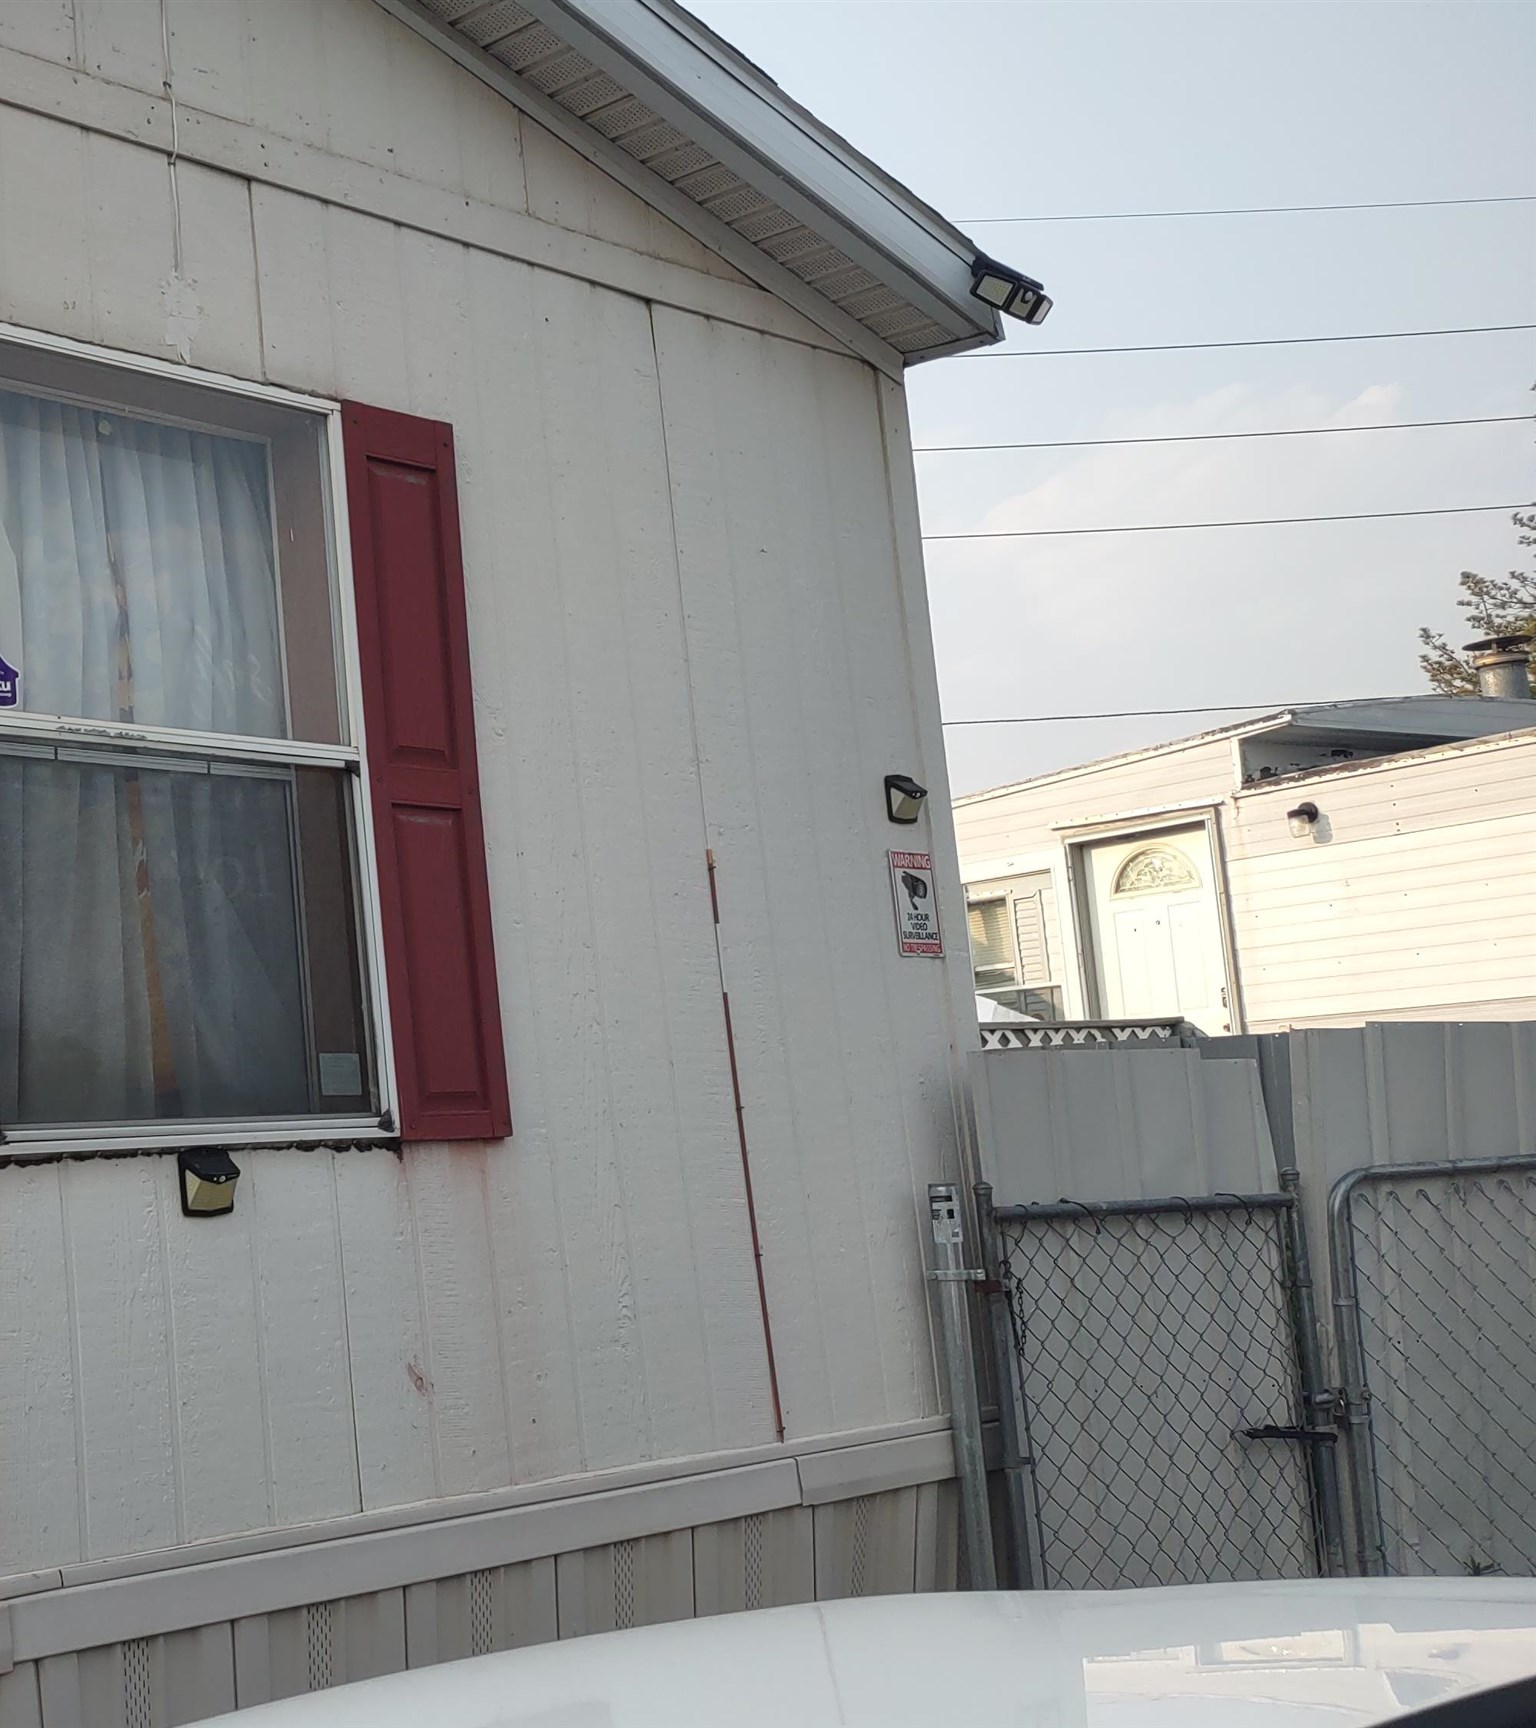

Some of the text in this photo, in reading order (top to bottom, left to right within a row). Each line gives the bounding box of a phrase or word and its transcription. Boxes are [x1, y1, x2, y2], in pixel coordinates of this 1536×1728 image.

[892, 852, 931, 869] WARNING
[907, 913, 930, 922] 24 HOUR
[910, 922, 928, 931] VIDEO
[903, 931, 939, 941] SURVEILLANCE
